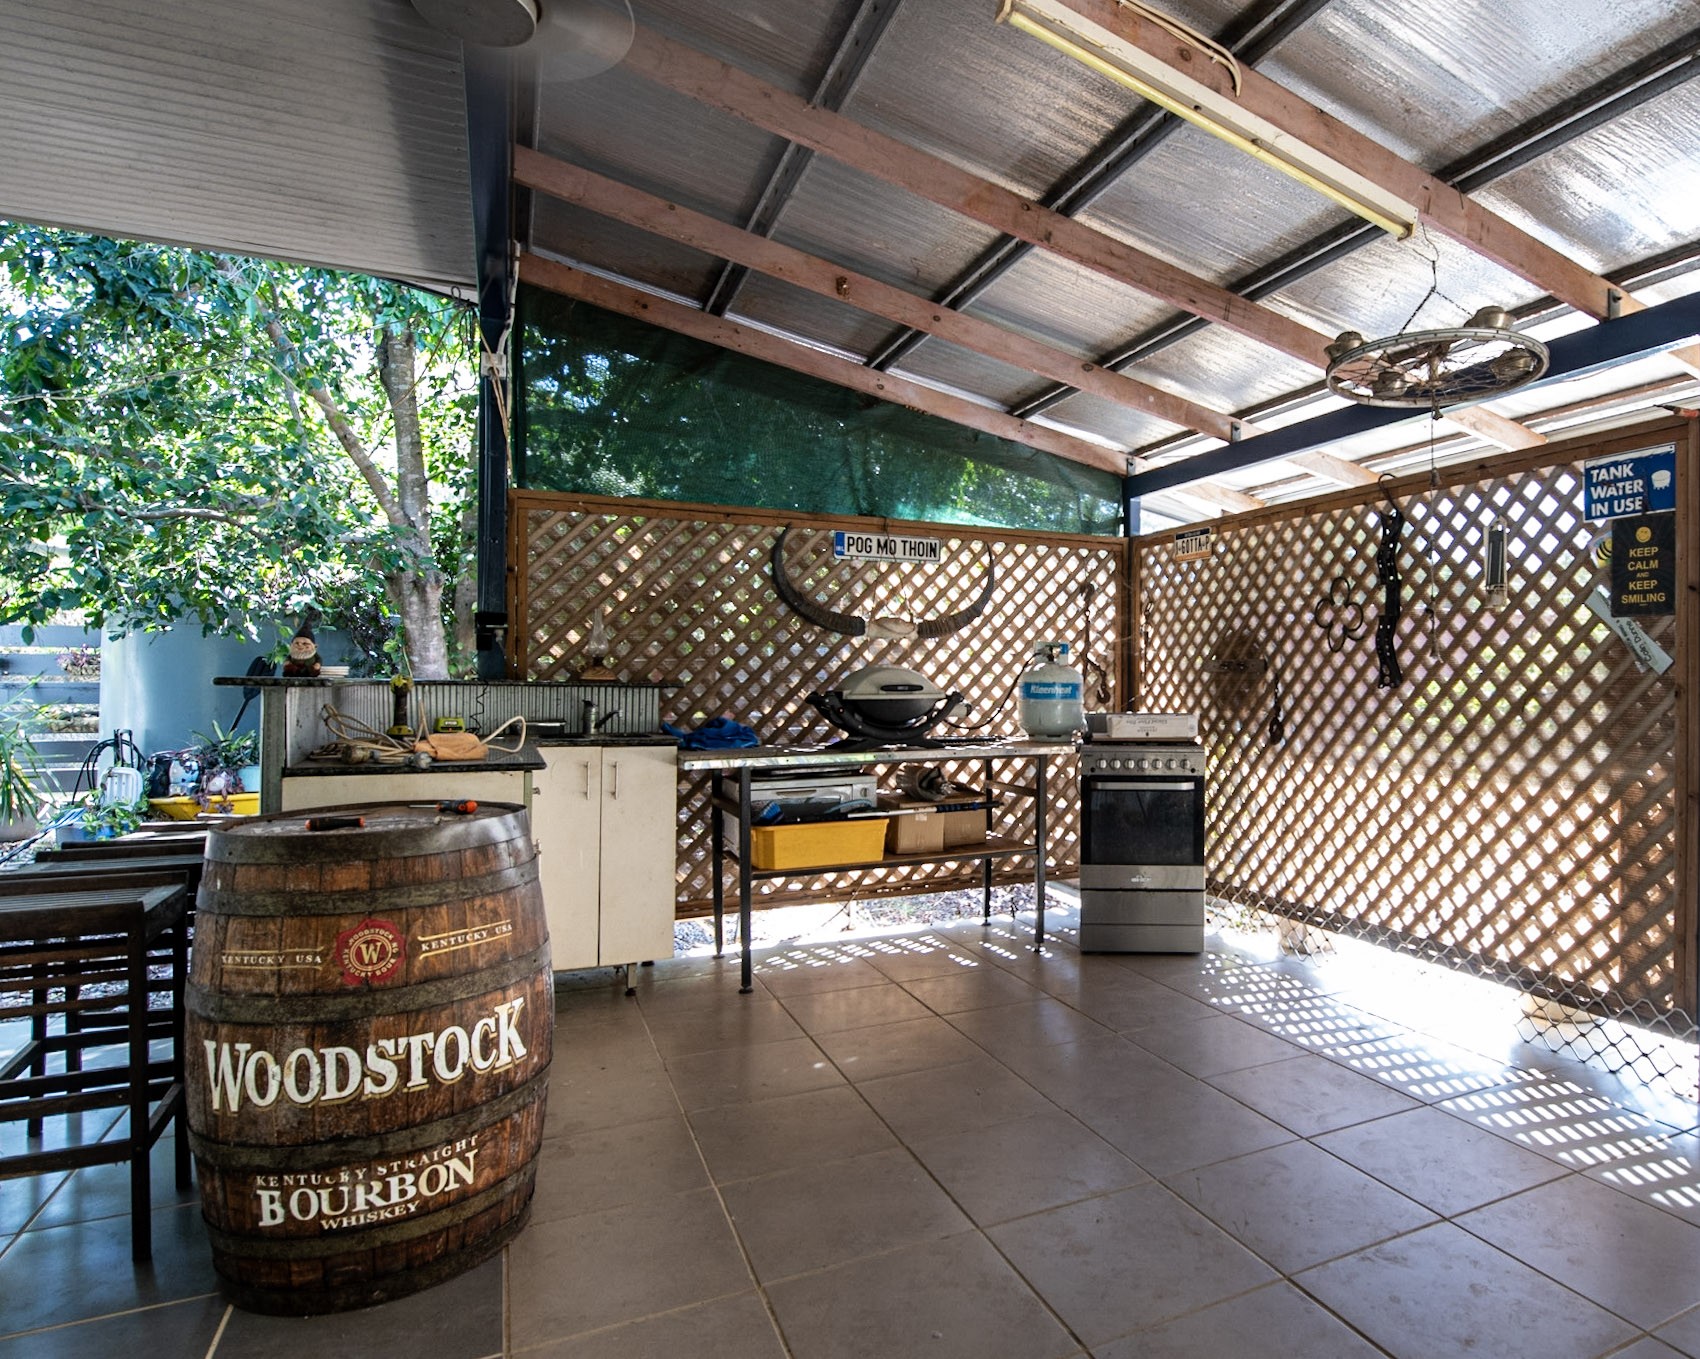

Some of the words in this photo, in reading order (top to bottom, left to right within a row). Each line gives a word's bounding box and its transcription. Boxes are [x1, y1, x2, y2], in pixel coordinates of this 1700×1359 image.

[1590, 462, 1634, 483] TANK
[1590, 479, 1644, 500] WATER
[1591, 501, 1609, 517] IN
[1613, 496, 1643, 514] USE
[847, 536, 873, 554] POG
[901, 540, 938, 558] THOIN
[1629, 546, 1659, 558] KEEP
[1627, 560, 1659, 571] CALM
[1628, 579, 1658, 591] KEEP
[1621, 592, 1666, 604] SMILING
[348, 928, 394, 946] WOODSTOCK
[421, 930, 488, 951] KENTUCKY
[495, 923, 513, 934] USA
[295, 954, 322, 964] USA
[359, 941, 382, 965] W
[203, 997, 528, 1113] WOODSTOCK
[377, 1134, 478, 1176] STRAIGHT
[256, 1148, 479, 1227] BOURBON
[320, 1199, 420, 1230] WHISKEY
